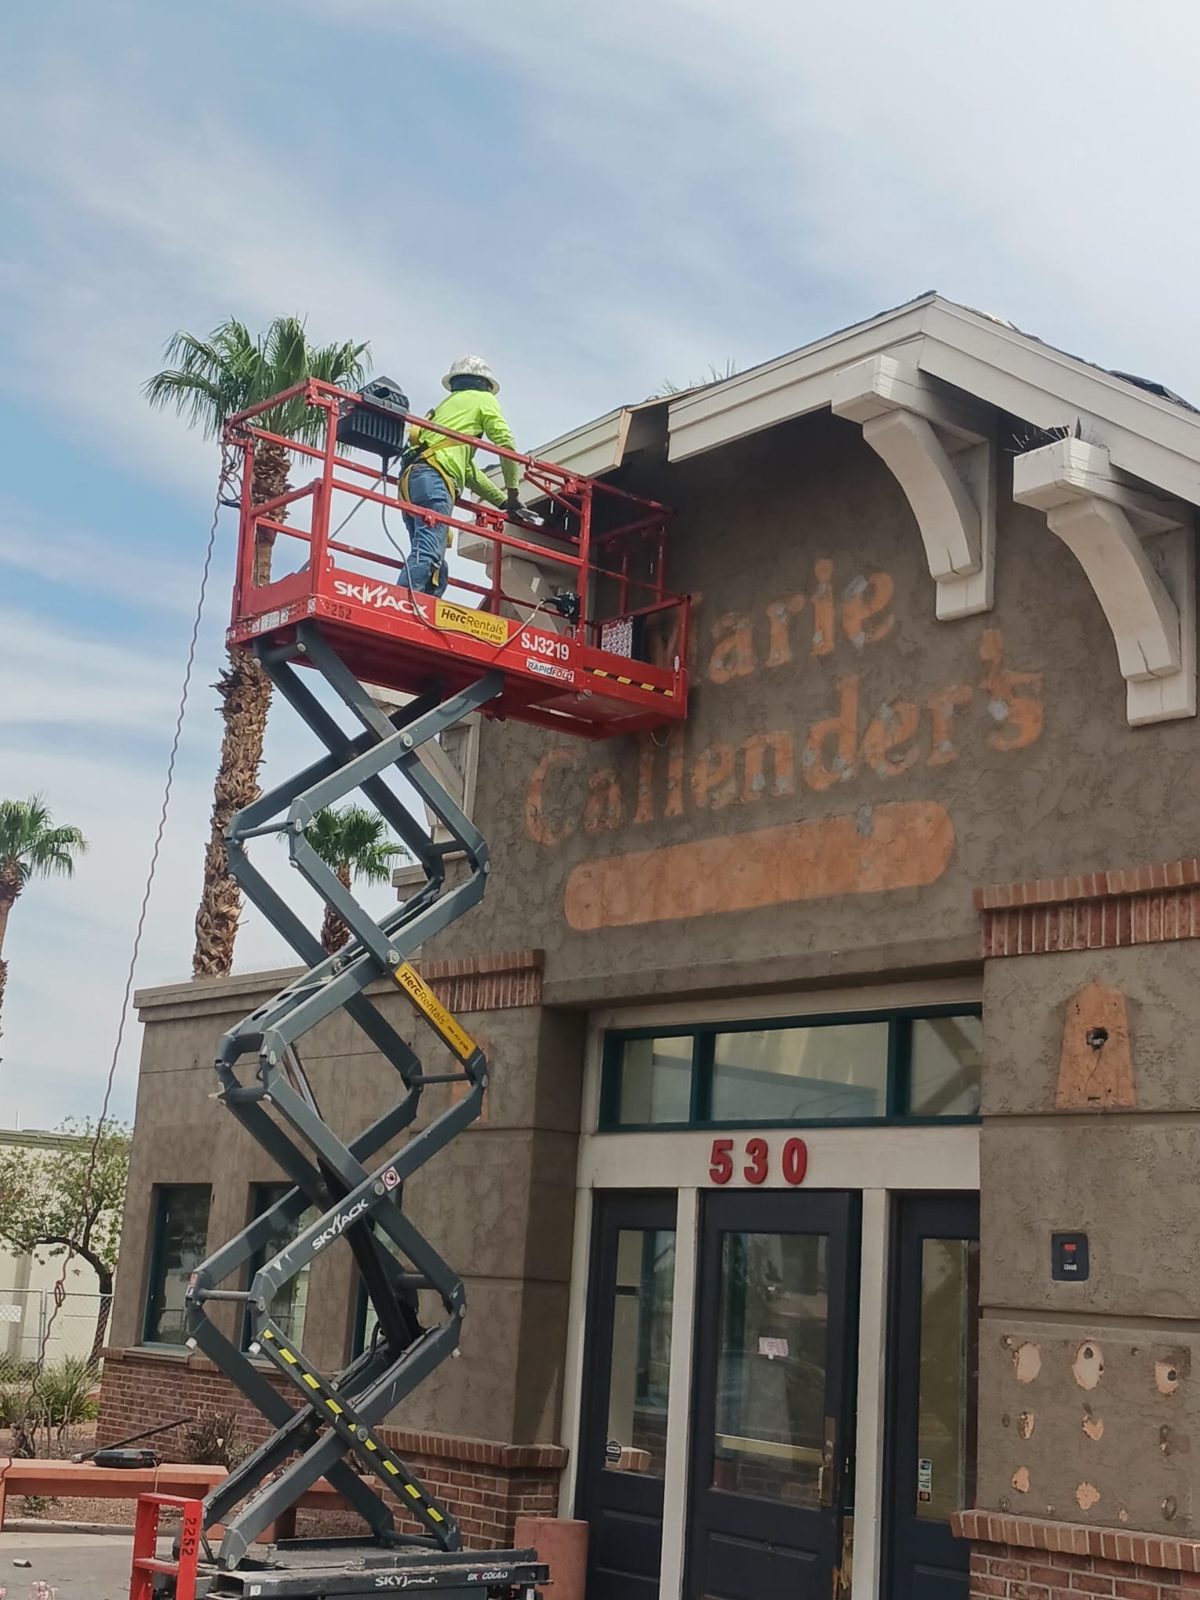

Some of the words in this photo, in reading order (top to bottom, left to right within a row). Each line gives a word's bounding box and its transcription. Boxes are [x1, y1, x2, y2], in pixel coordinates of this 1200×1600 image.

[333, 580, 430, 619] SKYJACK
[520, 631, 570, 661] SJ3219
[708, 1137, 808, 1186] 530
[312, 1198, 369, 1250] SKYJACK
[181, 1517, 197, 1556] 2252
